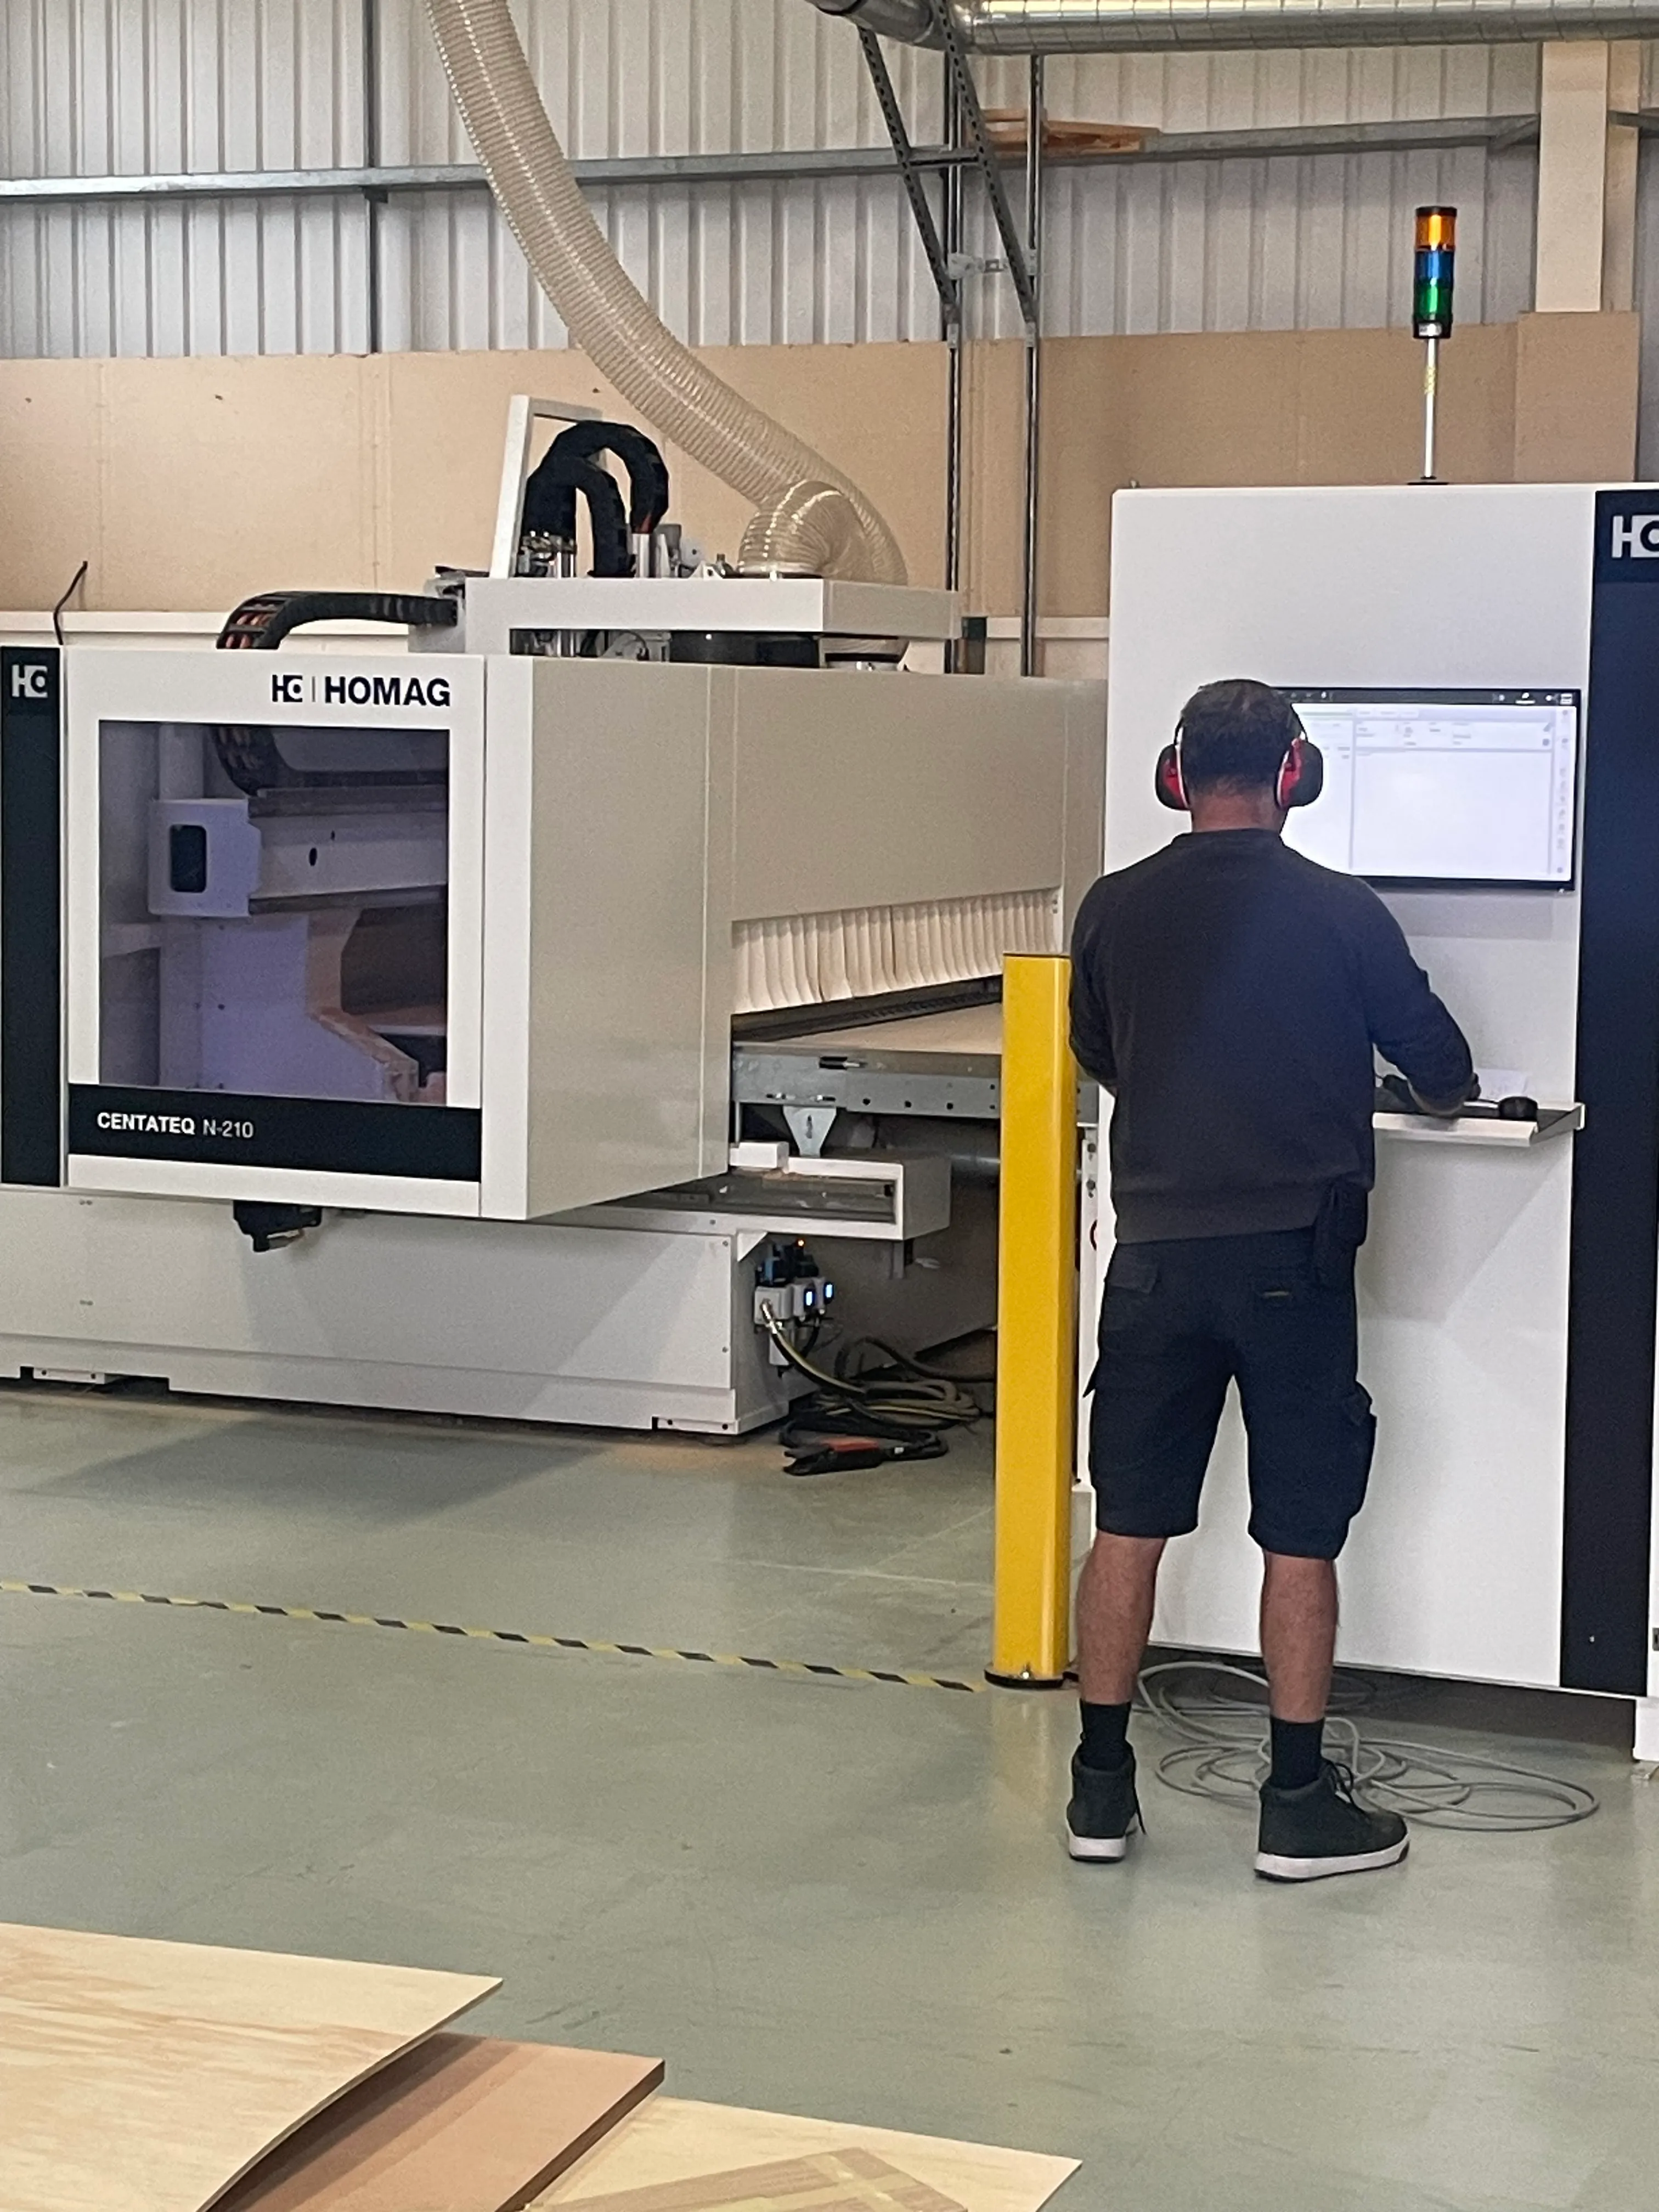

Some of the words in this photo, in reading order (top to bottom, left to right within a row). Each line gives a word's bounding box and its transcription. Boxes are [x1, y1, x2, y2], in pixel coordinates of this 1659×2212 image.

[325, 676, 450, 706] HOMAG
[97, 1112, 195, 1135] CENTATEQ
[202, 1119, 253, 1138] N-210
